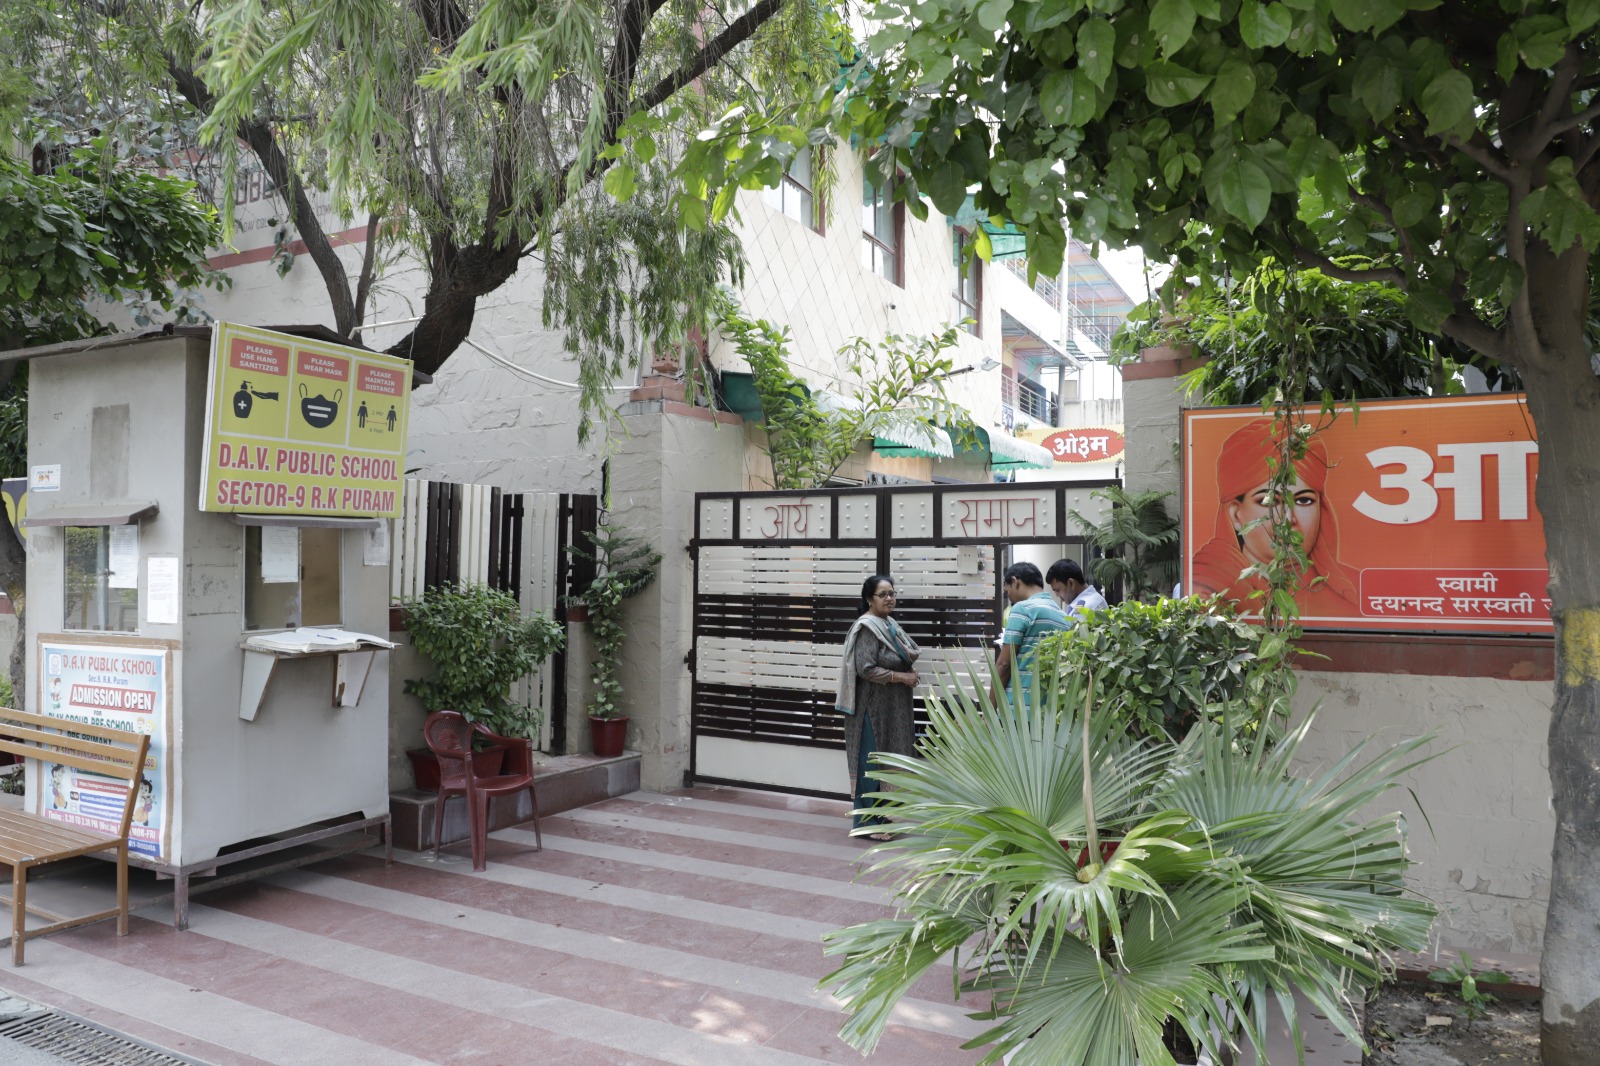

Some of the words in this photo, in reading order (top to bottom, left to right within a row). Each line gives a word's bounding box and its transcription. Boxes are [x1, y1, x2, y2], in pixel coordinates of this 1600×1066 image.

[246, 345, 273, 356] PLEASE
[240, 352, 254, 361] USE
[256, 354, 278, 365] HAND
[311, 357, 335, 368] PLEASE
[239, 360, 279, 373] SANITIZER
[303, 364, 323, 374] WEAR
[325, 366, 343, 377] MASK
[369, 370, 392, 379] PLEASE
[364, 376, 395, 387] MAINTAIN
[365, 384, 395, 394] DISTANCE
[218, 442, 270, 471] D.A.V.
[276, 448, 336, 477] PUBLIC
[340, 455, 398, 481] SCHOOL
[217, 479, 306, 509] SECTOR-9
[311, 486, 338, 510] R.K
[342, 488, 395, 512] PURAM
[760, 497, 814, 540] आर्य
[957, 498, 1040, 538] समाज
[1436, 571, 1499, 593] स्वामी
[1368, 596, 1446, 615] दयानन्द
[1450, 592, 1536, 614] सरस्वती
[62, 654, 86, 670] D.A.V
[88, 656, 119, 673] PUBLIC
[121, 658, 157, 676] SCHOOL
[113, 676, 129, 686] Puram
[72, 686, 122, 708] ADMISSION
[124, 691, 152, 711] OPEN
